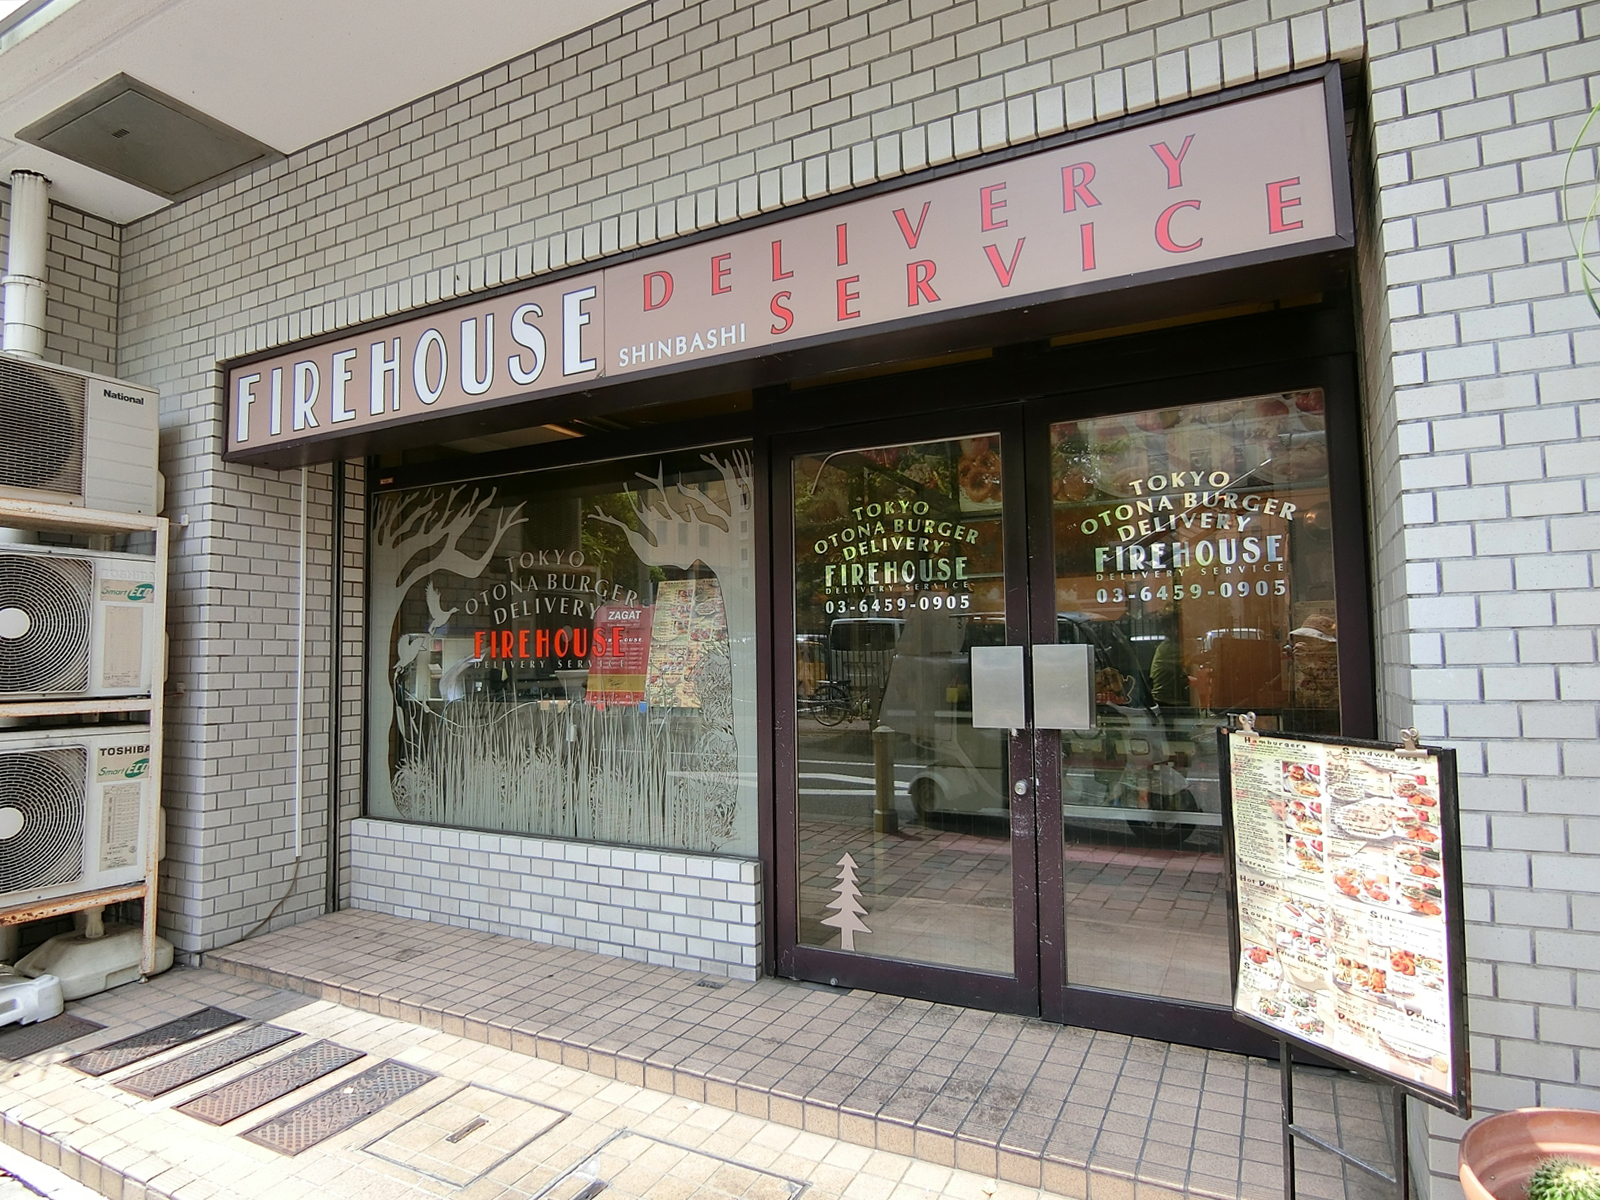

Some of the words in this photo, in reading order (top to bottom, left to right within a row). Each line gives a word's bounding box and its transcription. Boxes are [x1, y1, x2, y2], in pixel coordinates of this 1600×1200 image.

[643, 133, 1196, 312] DELIVERY
[770, 176, 1303, 335] SERVICE
[619, 323, 746, 367] SHINBASHI
[236, 286, 597, 442] FIREHOUSE
[103, 389, 144, 405] National
[1129, 471, 1230, 496] TOKYO
[852, 500, 929, 521] TOKYO
[1080, 495, 1173, 535] OTONA
[1184, 492, 1297, 521] BURGER
[814, 521, 885, 555] OTONA
[894, 518, 979, 545] BURGER
[1117, 512, 1251, 542] DELIVERY
[842, 536, 944, 561] DELIVERY
[1095, 534, 1284, 573] FIREHOUSE
[505, 549, 585, 573] TOKYO
[825, 556, 968, 587] FIREHOUSE
[1096, 569, 1185, 581] DELIVERY
[1201, 563, 1284, 576] SERVICE
[101, 586, 128, 596] Smart
[465, 575, 538, 615] OTONA
[548, 573, 638, 609] BURGER
[826, 585, 894, 595] DELIVERY
[906, 581, 969, 591] SERVICE
[1096, 579, 1286, 603] 03-6459-0905
[494, 597, 601, 625] DELIVERY
[608, 610, 642, 620] ZAGAT
[825, 595, 970, 614] 03-6459-0905
[474, 626, 626, 659] FIREHOUSE
[474, 660, 546, 669] DELIVERY
[1244, 736, 1306, 749] Hamburgers
[98, 766, 126, 776] Smart
[1240, 875, 1255, 884] Hot
[1370, 910, 1403, 924] Sides
